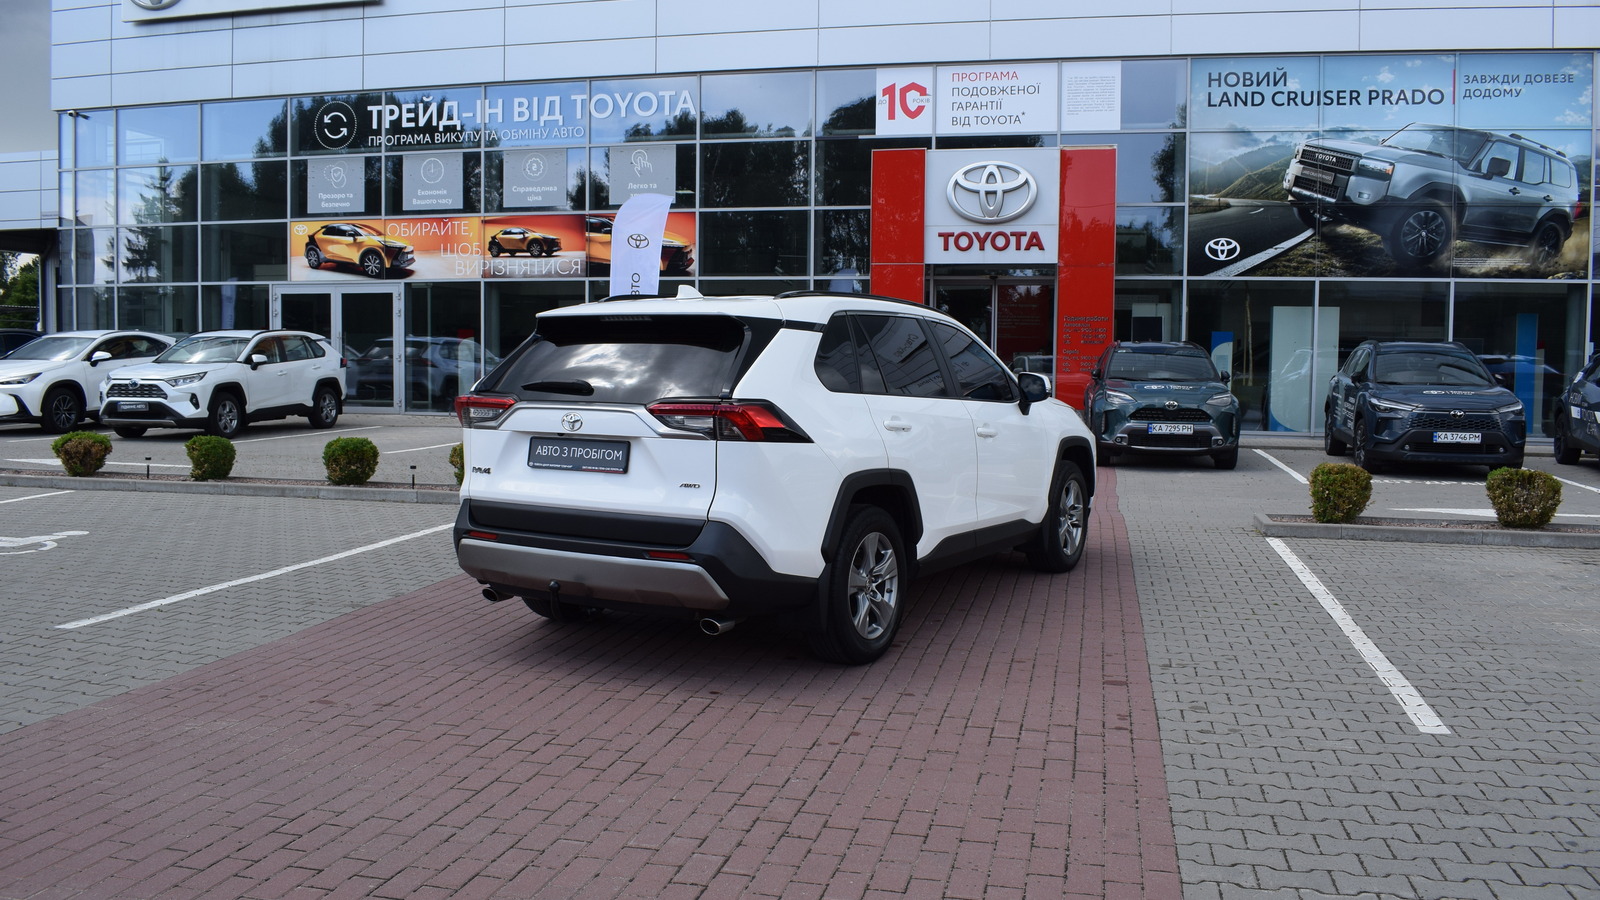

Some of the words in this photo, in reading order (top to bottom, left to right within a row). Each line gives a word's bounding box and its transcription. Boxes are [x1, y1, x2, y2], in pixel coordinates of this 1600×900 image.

[952, 71, 1019, 82] ПРОГРАМА
[1208, 67, 1288, 87] НОВИЙ
[1464, 74, 1520, 86] ЗАВЖДИ
[1524, 74, 1574, 85] ДОВЕЗЕ
[952, 83, 1041, 98] ПОДОВЖЕНОЇ
[1463, 88, 1522, 100] ДОДОМУ
[1207, 91, 1266, 107] LAND
[1271, 90, 1361, 107] CRUISER
[1368, 88, 1445, 105] PRADO
[952, 98, 1004, 111] ГАРАНТІЇ
[367, 96, 503, 132] ТРЕЙД-ІН
[513, 95, 564, 127] ВІД
[571, 90, 697, 120] TOYOTA
[952, 116, 971, 127] ВІД
[368, 133, 432, 147] ПРОГРАМА
[434, 131, 482, 144] ВИКУПУ
[484, 130, 498, 142] ТА
[501, 127, 550, 140] ОБМІНУ
[552, 126, 585, 138] АВТО
[1315, 153, 1336, 162] TOYOTA
[417, 188, 448, 196] Економія
[512, 185, 558, 193] Справедлива
[627, 182, 648, 190] Легко
[318, 192, 347, 201] Прозоро
[437, 198, 453, 206] часу
[527, 194, 543, 202] ціна
[387, 218, 474, 238] ОБИРАЙТЕ,
[938, 231, 1045, 251] TOYOTA
[440, 242, 481, 258] ЩОБ
[455, 258, 582, 276] ВИРІЗНЯТИСЯ
[630, 272, 641, 295] ВТО
[1437, 432, 1449, 441] KA
[1450, 433, 1468, 441] 3746
[1469, 433, 1481, 441] PM
[535, 445, 560, 457] АВТО
[562, 447, 569, 457] З
[570, 447, 623, 461] ПРОБІГОМ
